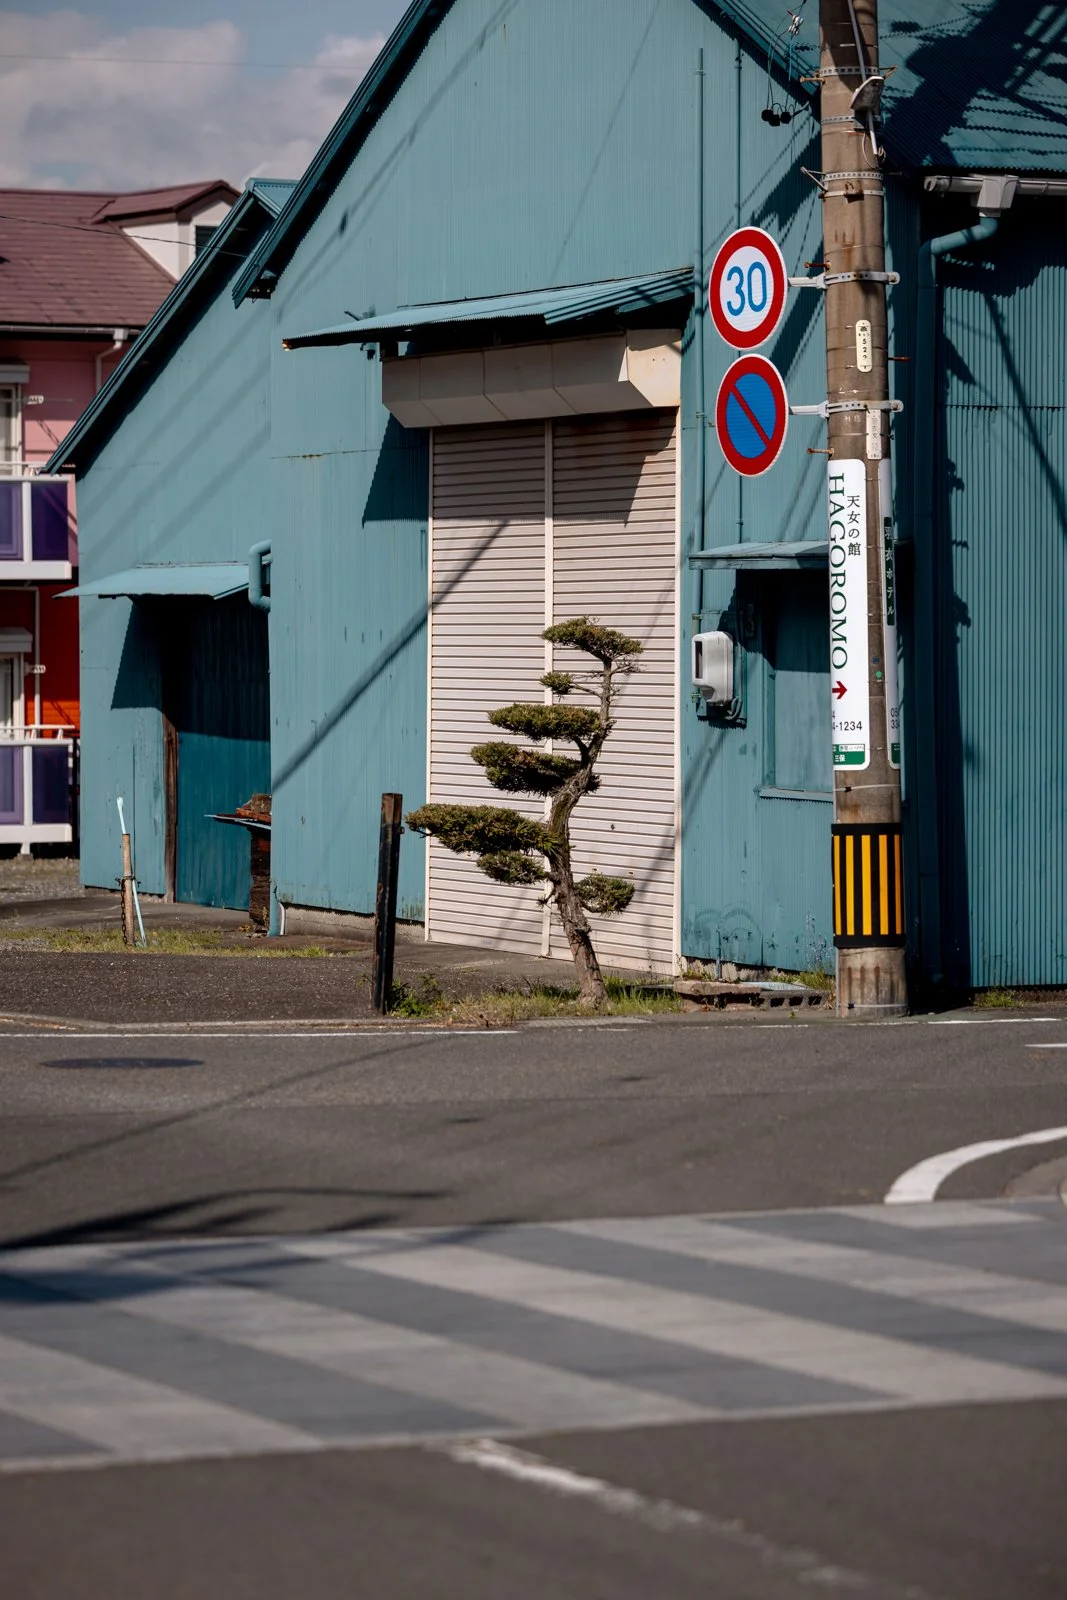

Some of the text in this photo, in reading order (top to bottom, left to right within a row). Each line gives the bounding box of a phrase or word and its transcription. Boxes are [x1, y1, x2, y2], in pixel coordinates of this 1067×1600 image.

[726, 261, 767, 317] 30
[846, 495, 861, 556] 天女の館
[829, 473, 848, 669] HAGOROMO
